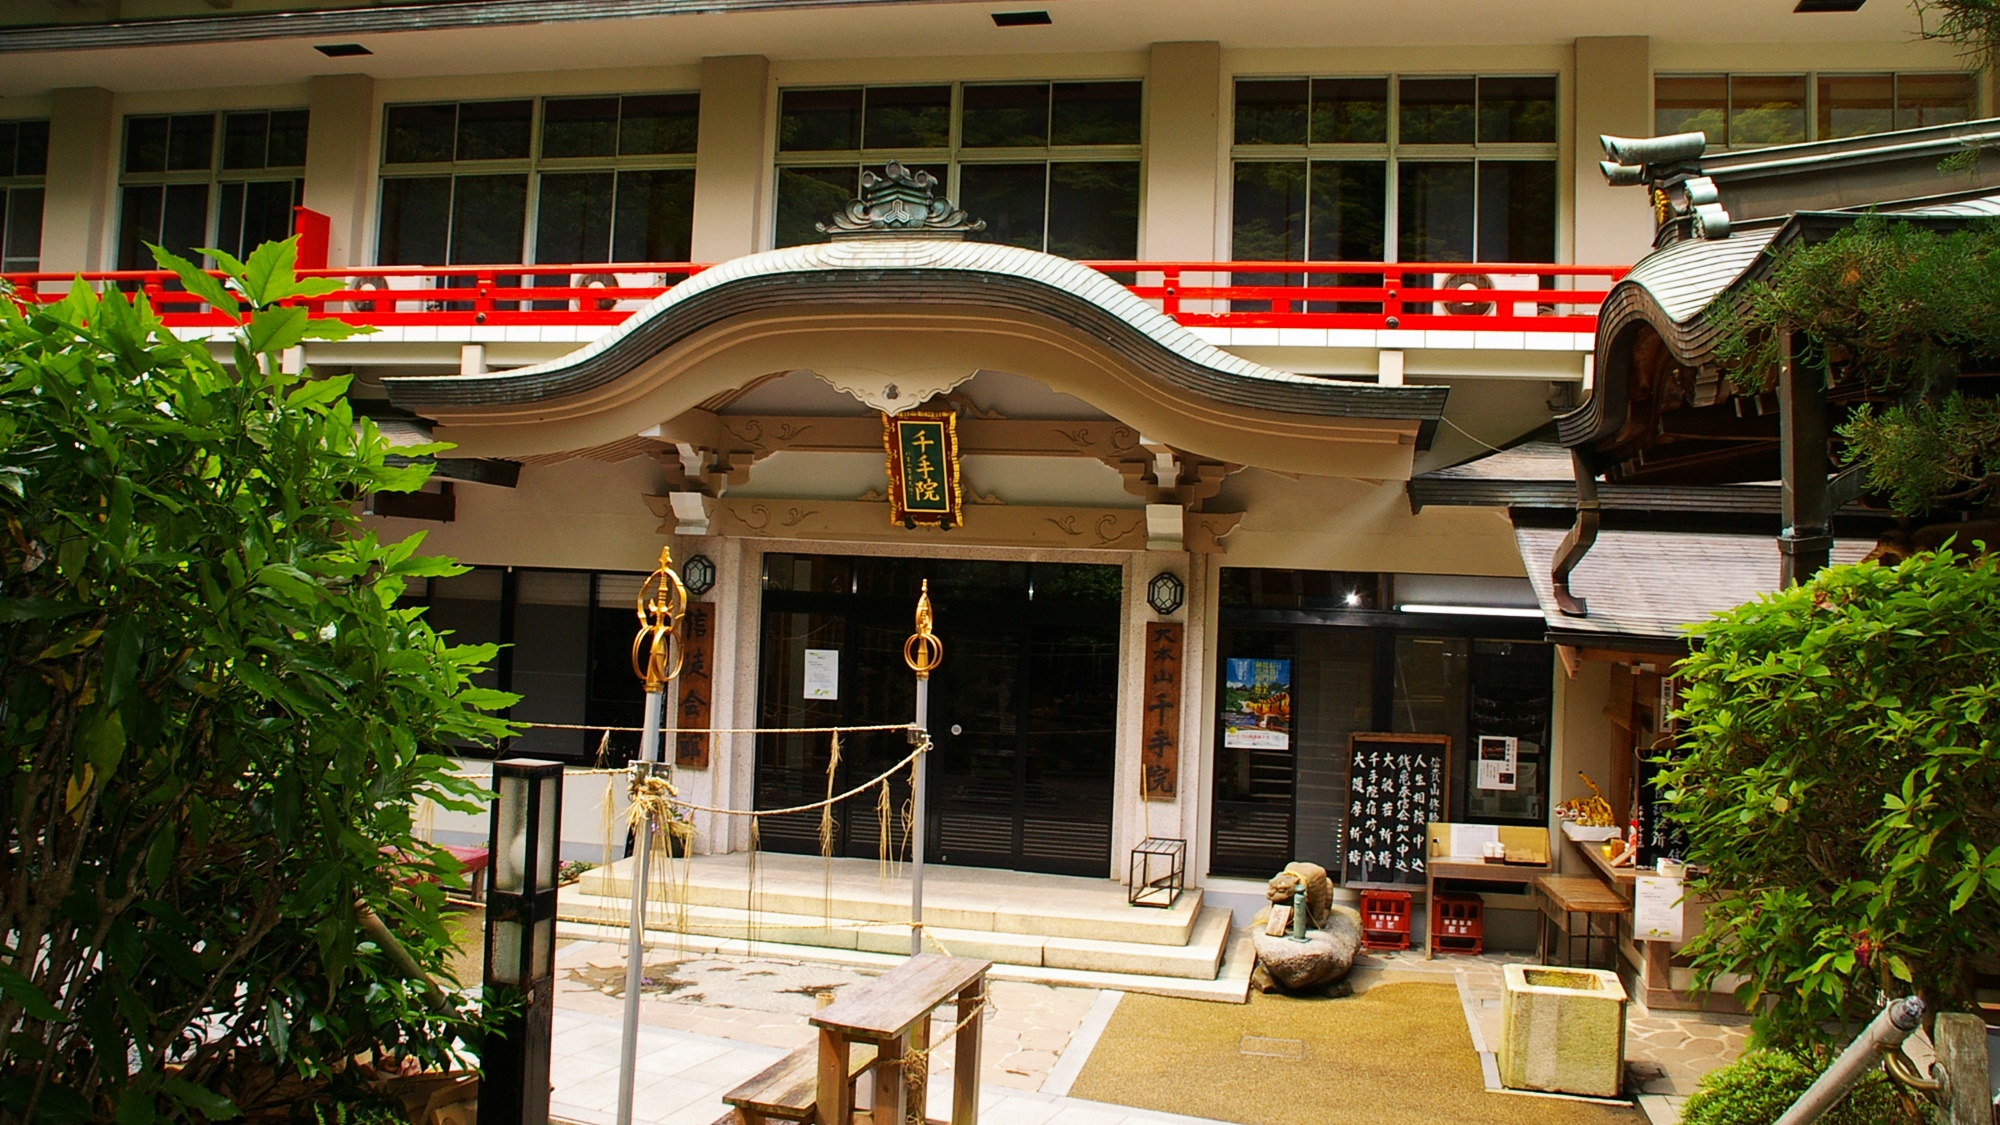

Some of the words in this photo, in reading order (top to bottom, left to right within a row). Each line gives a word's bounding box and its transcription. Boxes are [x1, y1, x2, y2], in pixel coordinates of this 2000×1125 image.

[912, 429, 940, 502] 千手院
[1147, 627, 1177, 794] 大本山千手院
[1411, 753, 1427, 873] 人生相談申込
